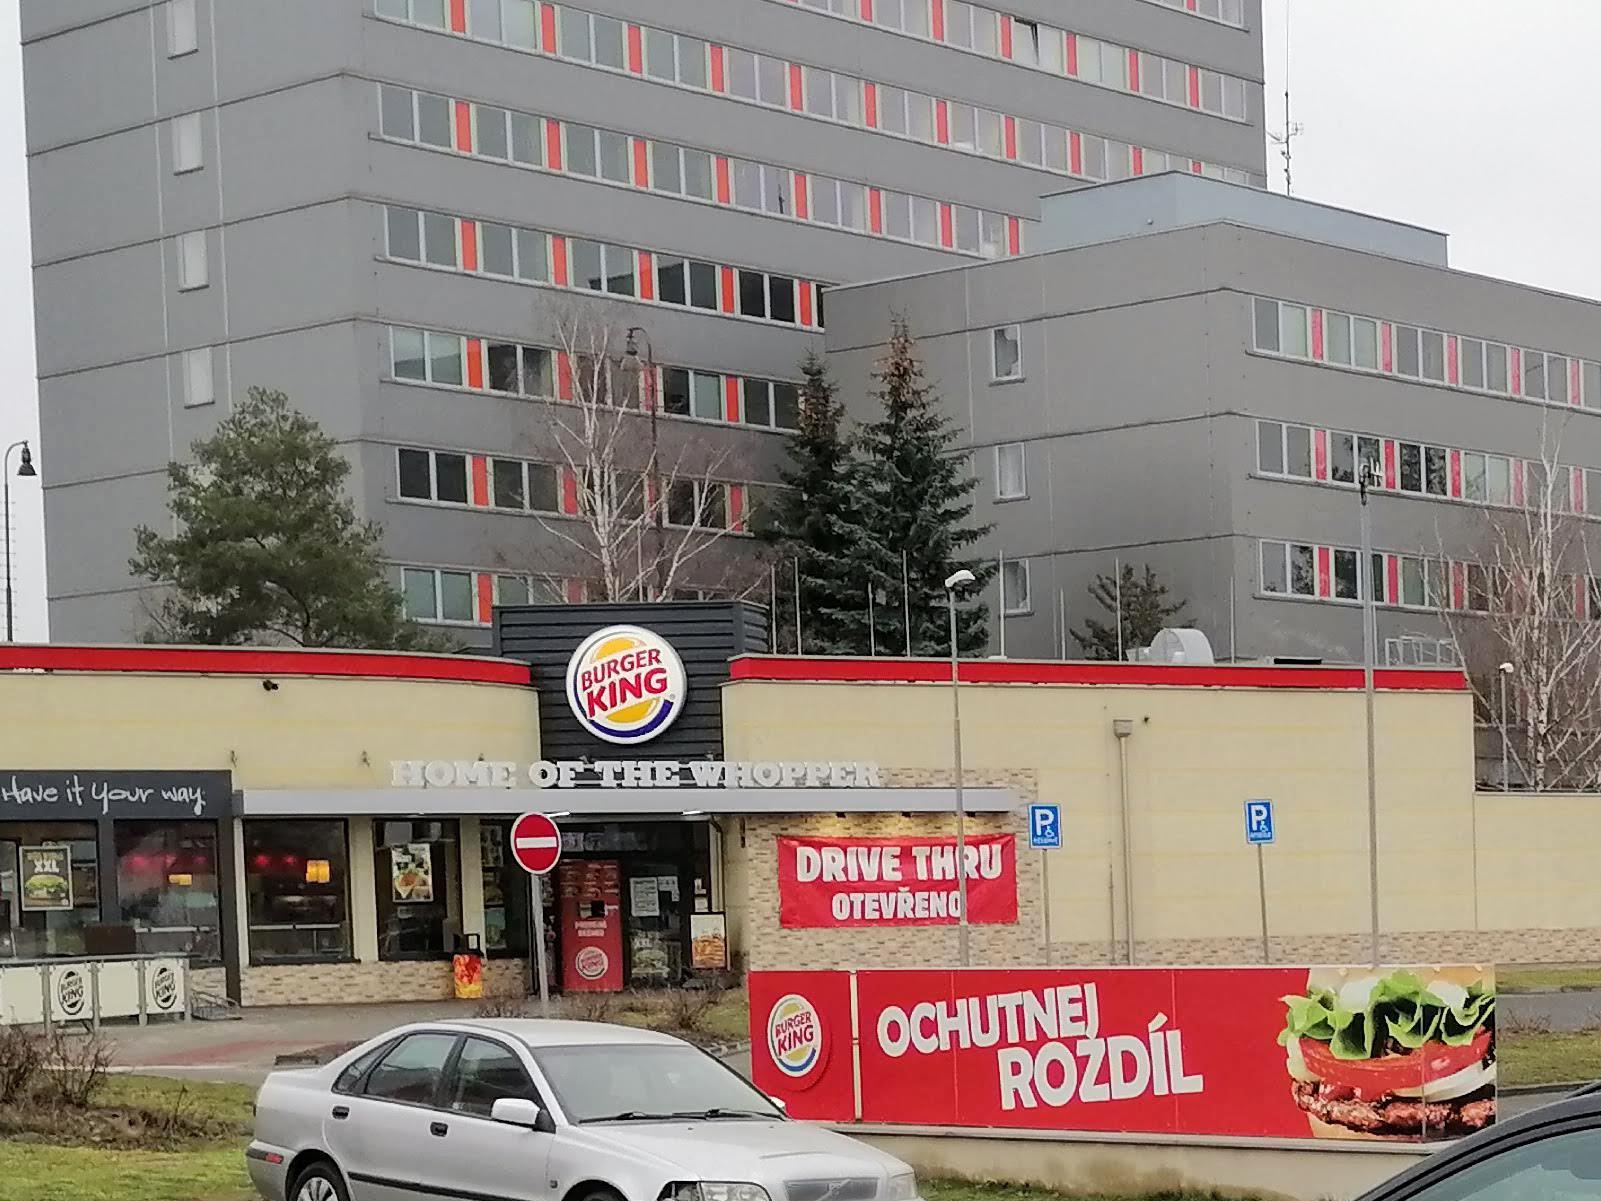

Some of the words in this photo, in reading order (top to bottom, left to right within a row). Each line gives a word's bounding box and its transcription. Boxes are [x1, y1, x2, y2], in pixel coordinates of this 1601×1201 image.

[581, 648, 662, 692] BURGER
[587, 667, 668, 718] KING
[391, 760, 517, 788] HOME
[528, 760, 584, 788] OF
[594, 760, 680, 788] THE
[688, 760, 880, 788] WHOPPER
[2, 775, 58, 804] Have
[66, 775, 84, 806] it
[1035, 808, 1055, 836] P
[1250, 805, 1268, 831] P
[34, 859, 60, 874] XXL
[796, 846, 903, 883] DRIVE
[912, 844, 1003, 881] THRU
[832, 887, 960, 921] OTEVŘENO
[775, 1011, 812, 1038] BURGER
[877, 982, 1099, 1058] OCHUTNEJ
[778, 1024, 814, 1056] KING
[997, 1012, 1204, 1111] ROZDÍL
